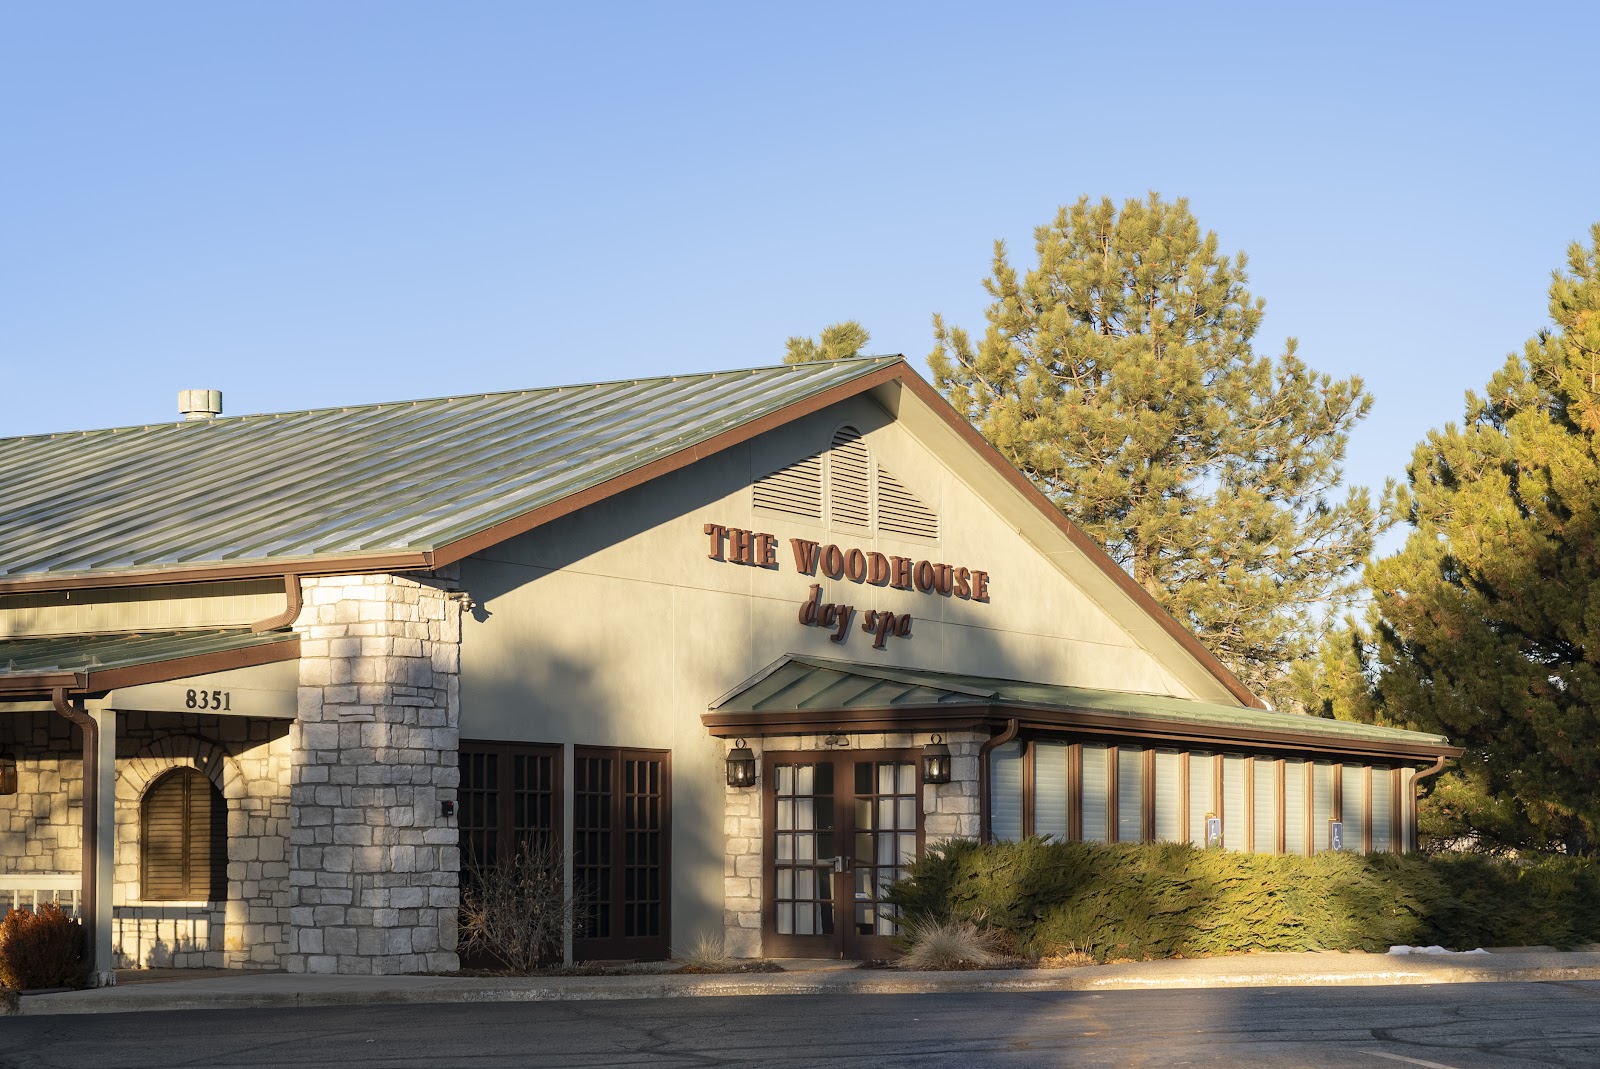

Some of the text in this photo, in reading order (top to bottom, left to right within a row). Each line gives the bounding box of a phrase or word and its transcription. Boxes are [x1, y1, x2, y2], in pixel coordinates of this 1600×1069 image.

[703, 523, 990, 602] THE WOODHOUSE
[799, 583, 912, 649] day spa
[185, 688, 231, 711] 8351
